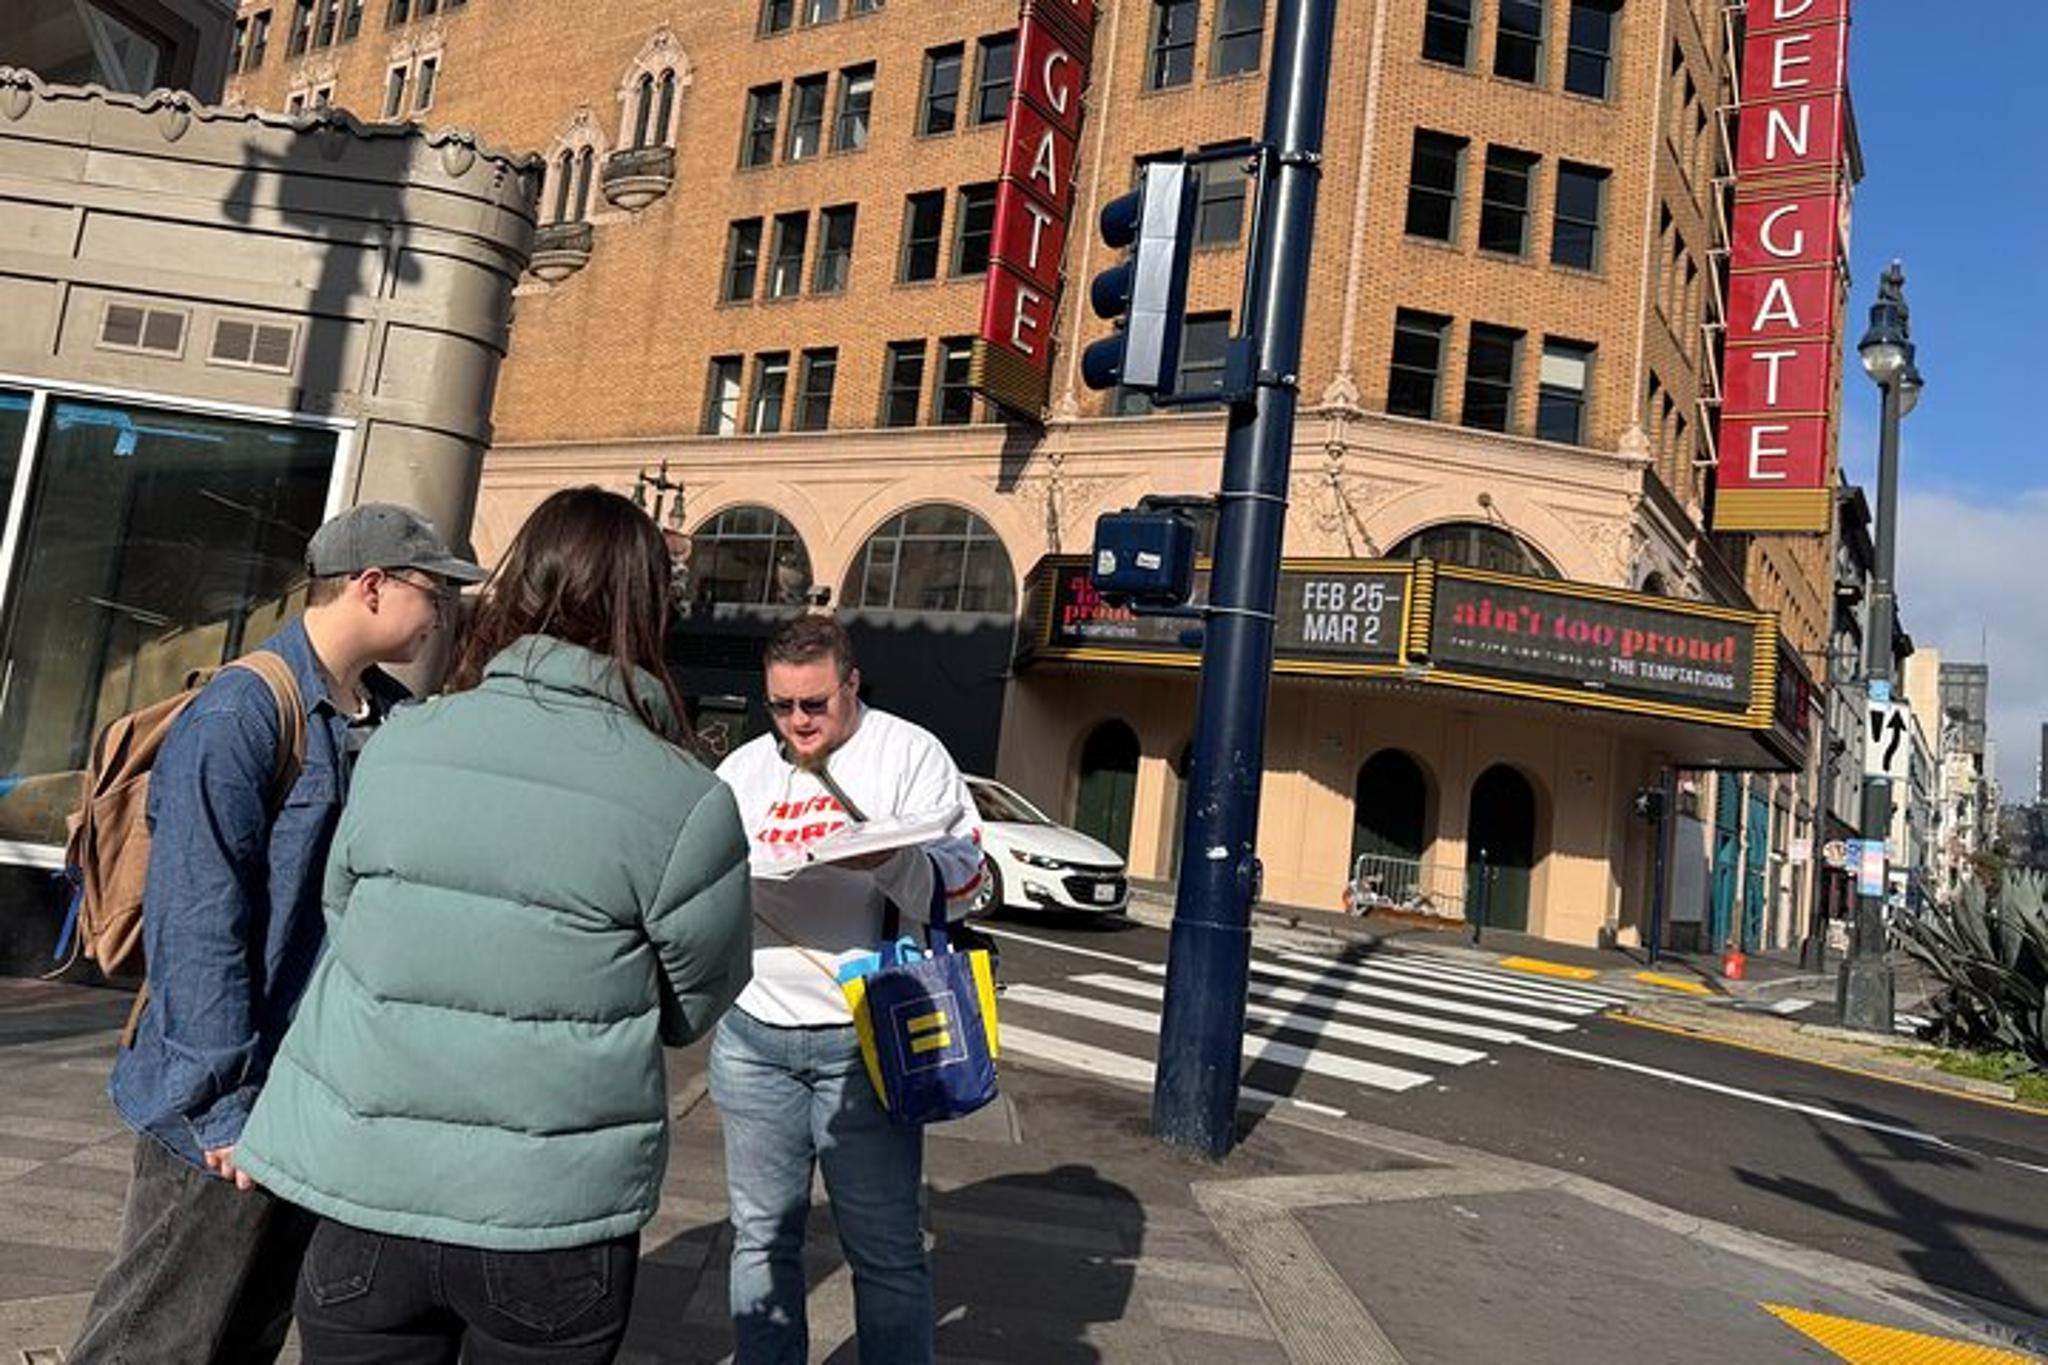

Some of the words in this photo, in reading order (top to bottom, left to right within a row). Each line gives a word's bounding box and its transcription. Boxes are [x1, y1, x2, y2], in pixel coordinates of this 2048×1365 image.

[1010, 50, 1069, 355] GATE
[1746, 203, 1804, 481] GATE
[1302, 581, 1346, 612] FEB
[1303, 613, 1358, 643] MAR
[1363, 614, 1380, 644] 2
[1455, 597, 1542, 636] ain't
[1552, 613, 1616, 648] too
[1620, 628, 1735, 663] proud
[1609, 656, 1636, 676] THE
[1640, 661, 1734, 689] TEMPTATIONS
